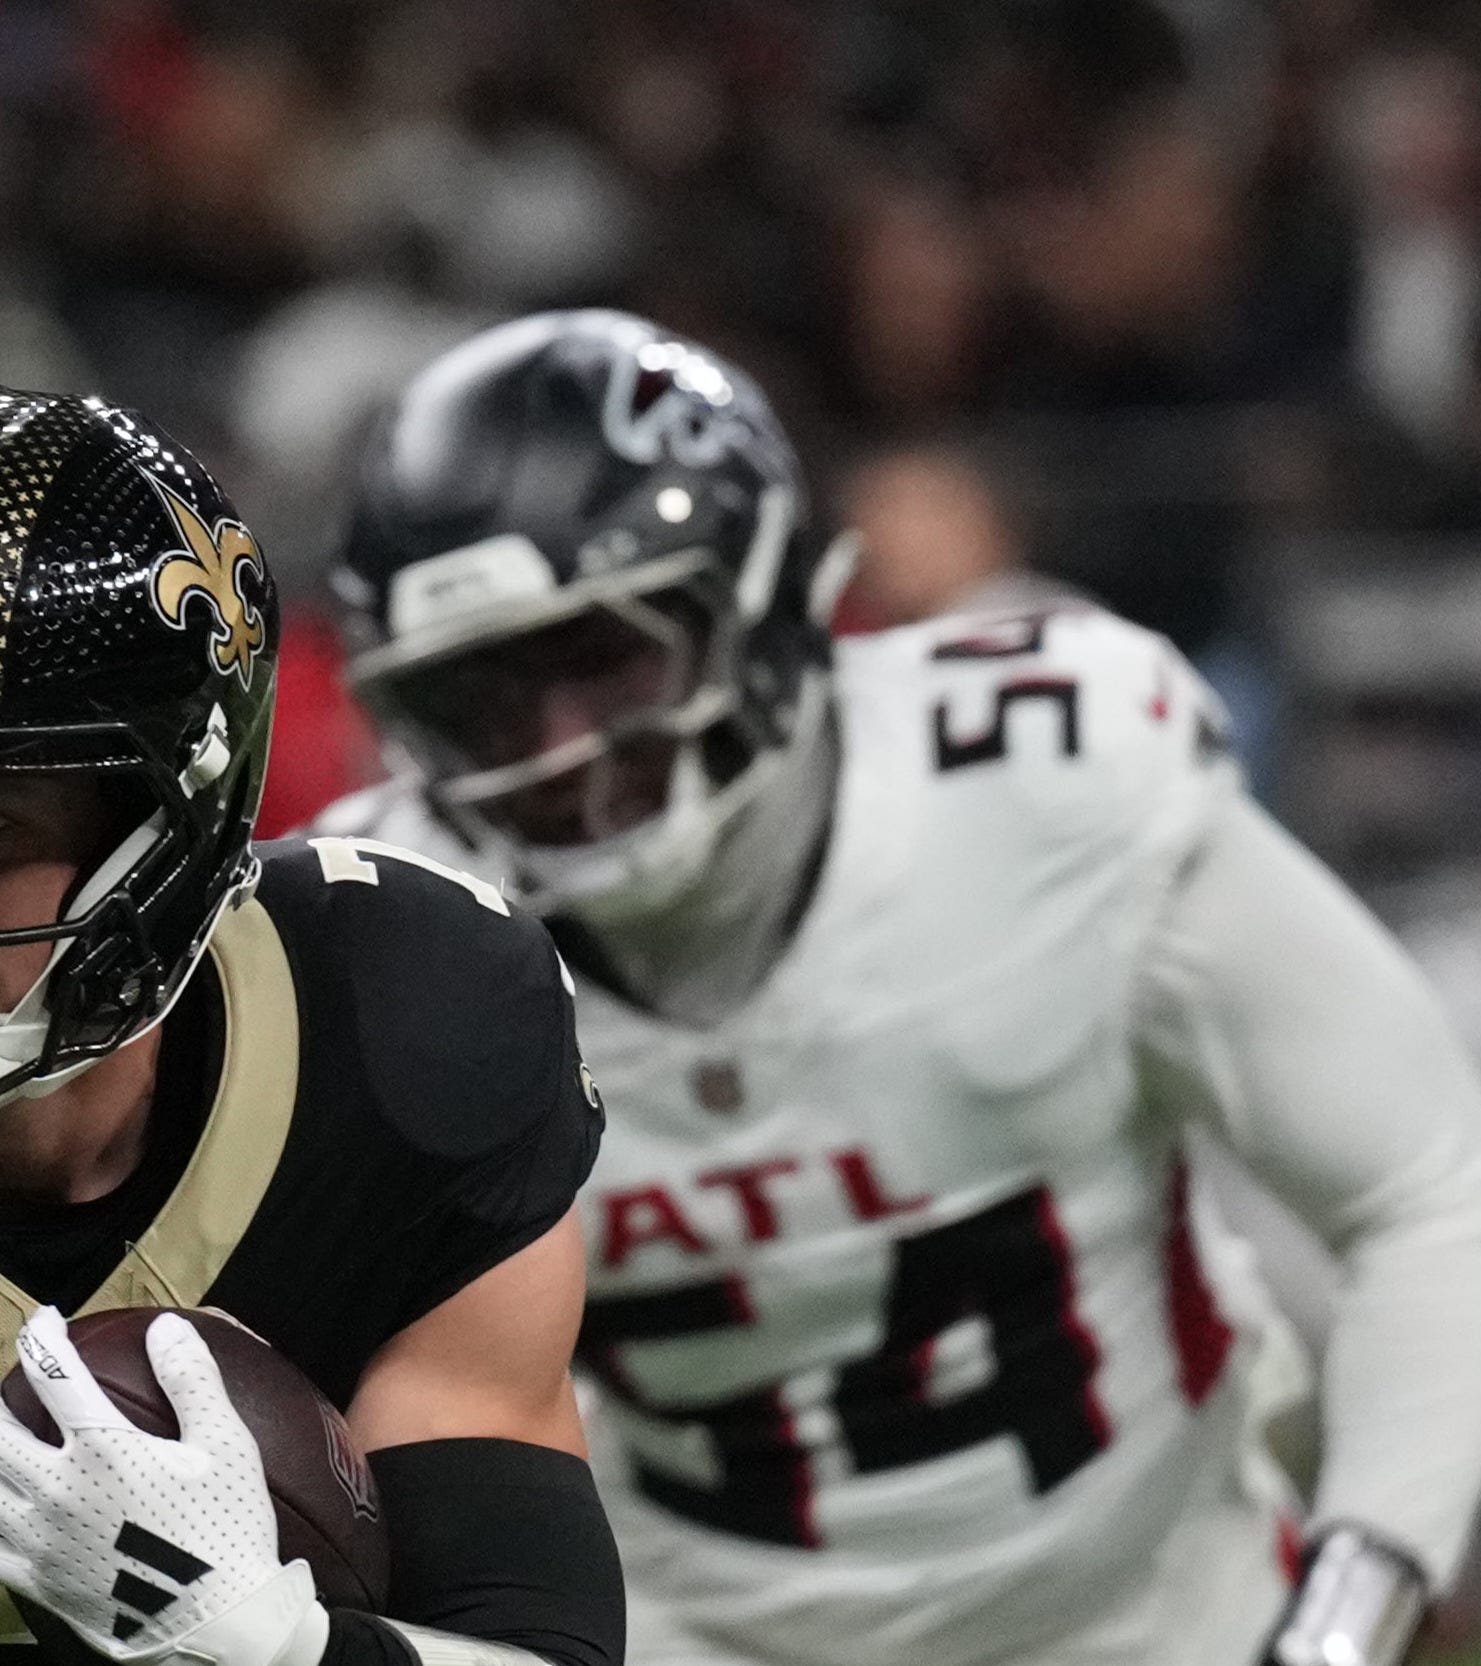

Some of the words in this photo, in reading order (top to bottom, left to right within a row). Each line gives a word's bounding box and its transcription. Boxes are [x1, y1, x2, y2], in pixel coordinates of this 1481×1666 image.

[307, 836, 510, 918] 7
[598, 1143, 932, 1270] ATL
[571, 1184, 1115, 1549] 54
